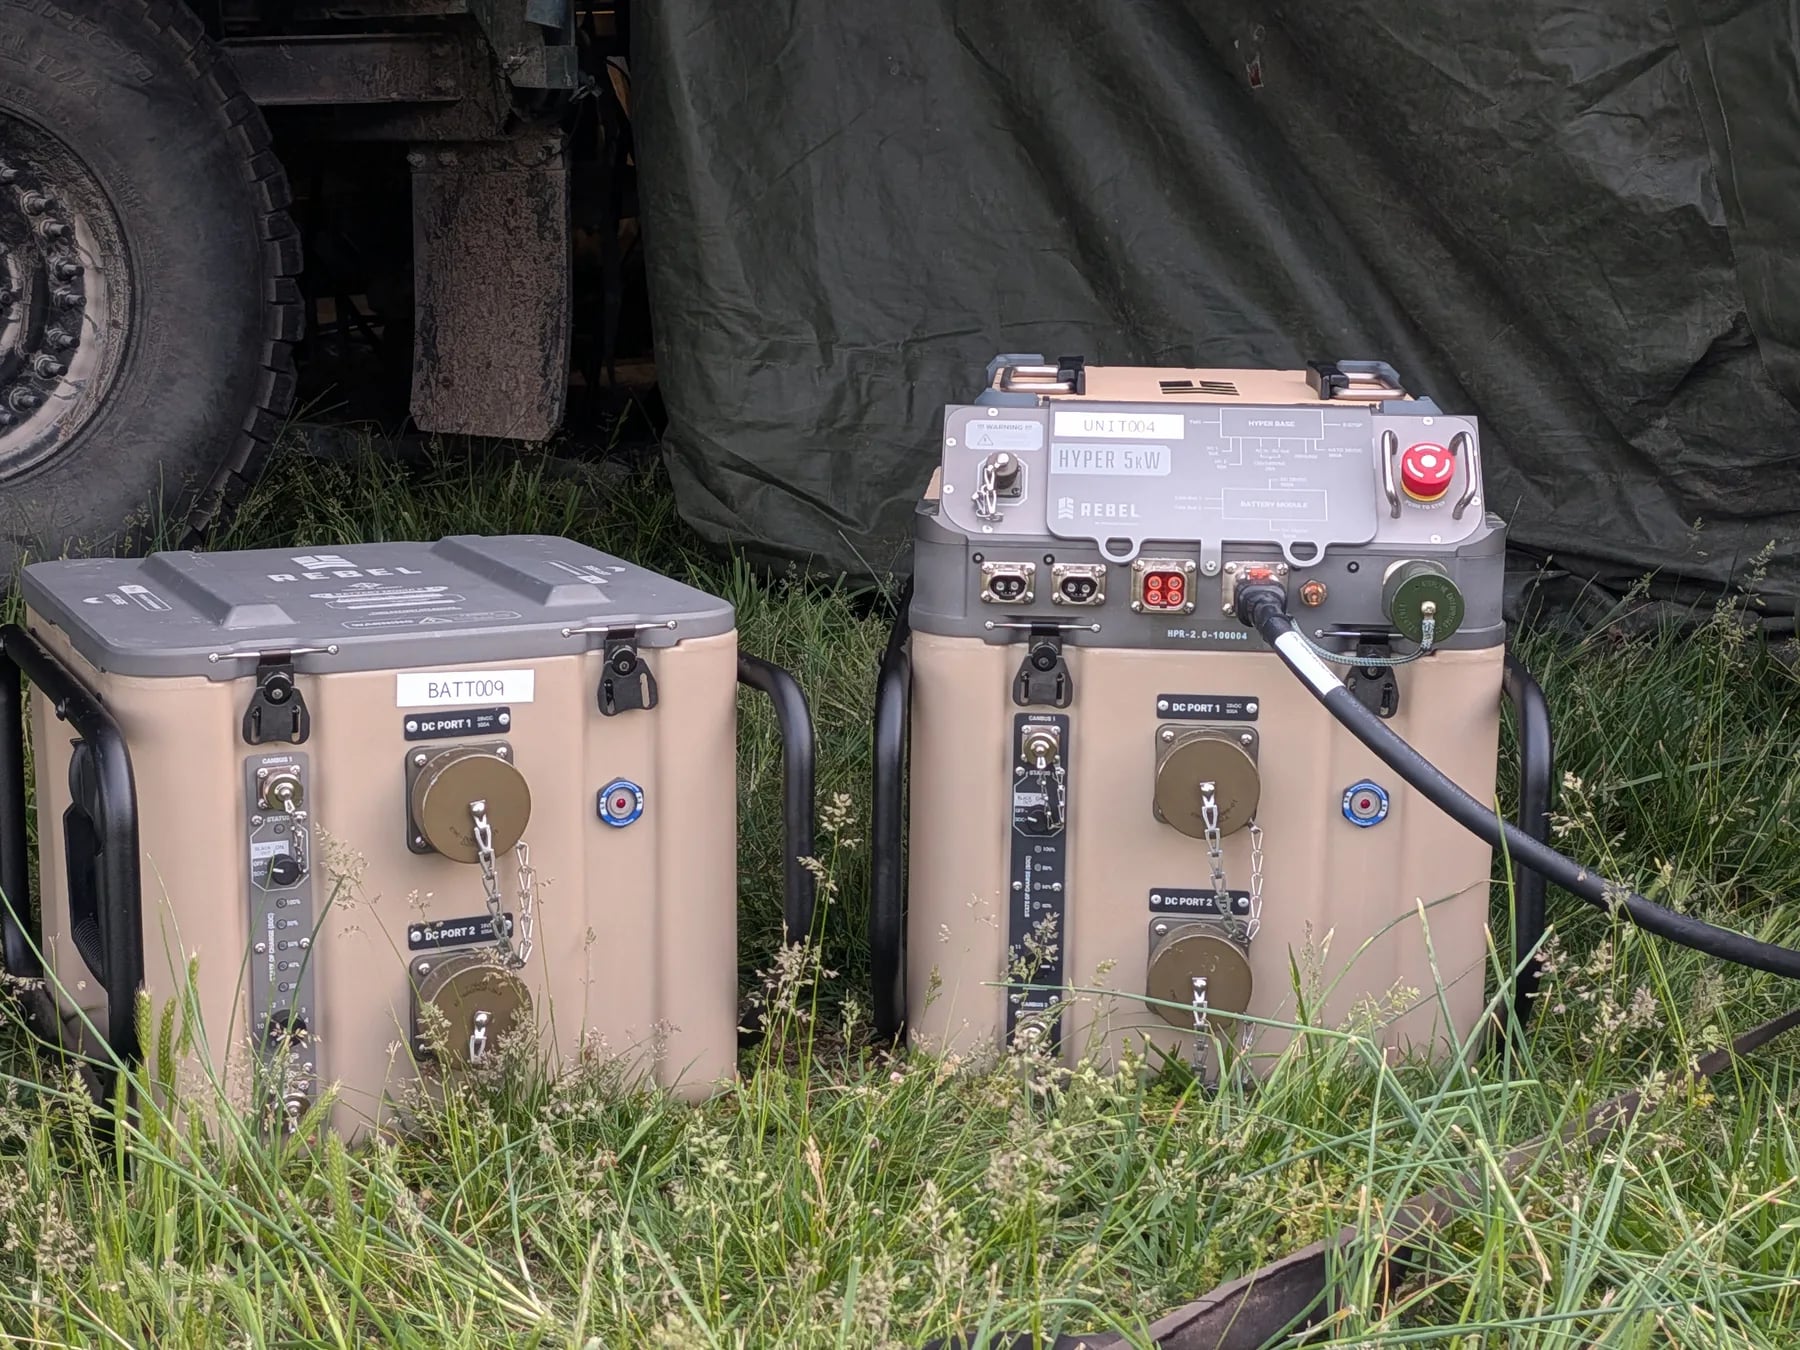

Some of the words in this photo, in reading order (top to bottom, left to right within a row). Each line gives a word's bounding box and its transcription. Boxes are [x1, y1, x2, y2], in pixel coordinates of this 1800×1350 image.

[1084, 419, 1156, 432] UNIT004
[1059, 450, 1115, 468] HYPER
[1080, 503, 1140, 518] REBEL
[268, 567, 422, 582] REBEL
[1168, 630, 1247, 640] HPR-2.0-100004
[428, 680, 504, 698] BATT009
[1172, 703, 1186, 712] DC
[1187, 703, 1214, 713] PORT
[1215, 704, 1220, 712] 1
[422, 722, 435, 732] DC
[437, 719, 464, 730] PORT
[466, 719, 471, 728] 1
[1165, 897, 1178, 905] DC
[1179, 898, 1205, 906] PORT
[425, 931, 439, 940] DC
[441, 927, 466, 939] PORT
[469, 926, 475, 935] 2
